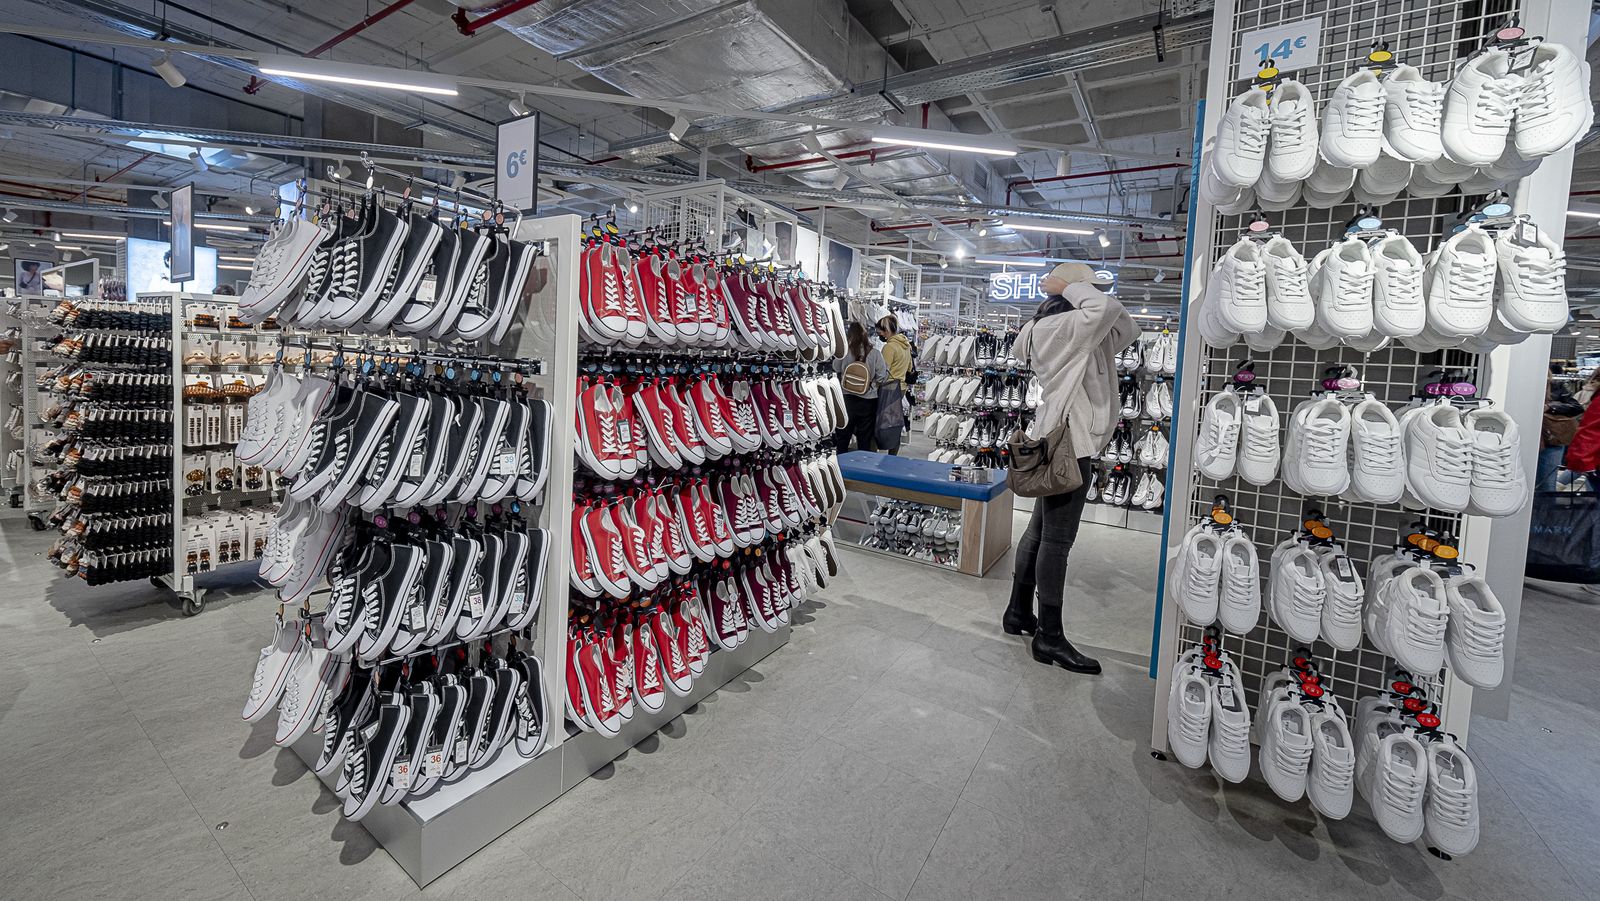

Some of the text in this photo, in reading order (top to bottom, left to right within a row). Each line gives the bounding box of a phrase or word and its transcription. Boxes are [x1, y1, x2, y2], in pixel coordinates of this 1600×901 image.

[1254, 36, 1307, 62] 14€
[506, 149, 527, 178] 6€
[505, 455, 514, 463] 39
[431, 754, 442, 763] 36
[398, 764, 409, 774] 36
